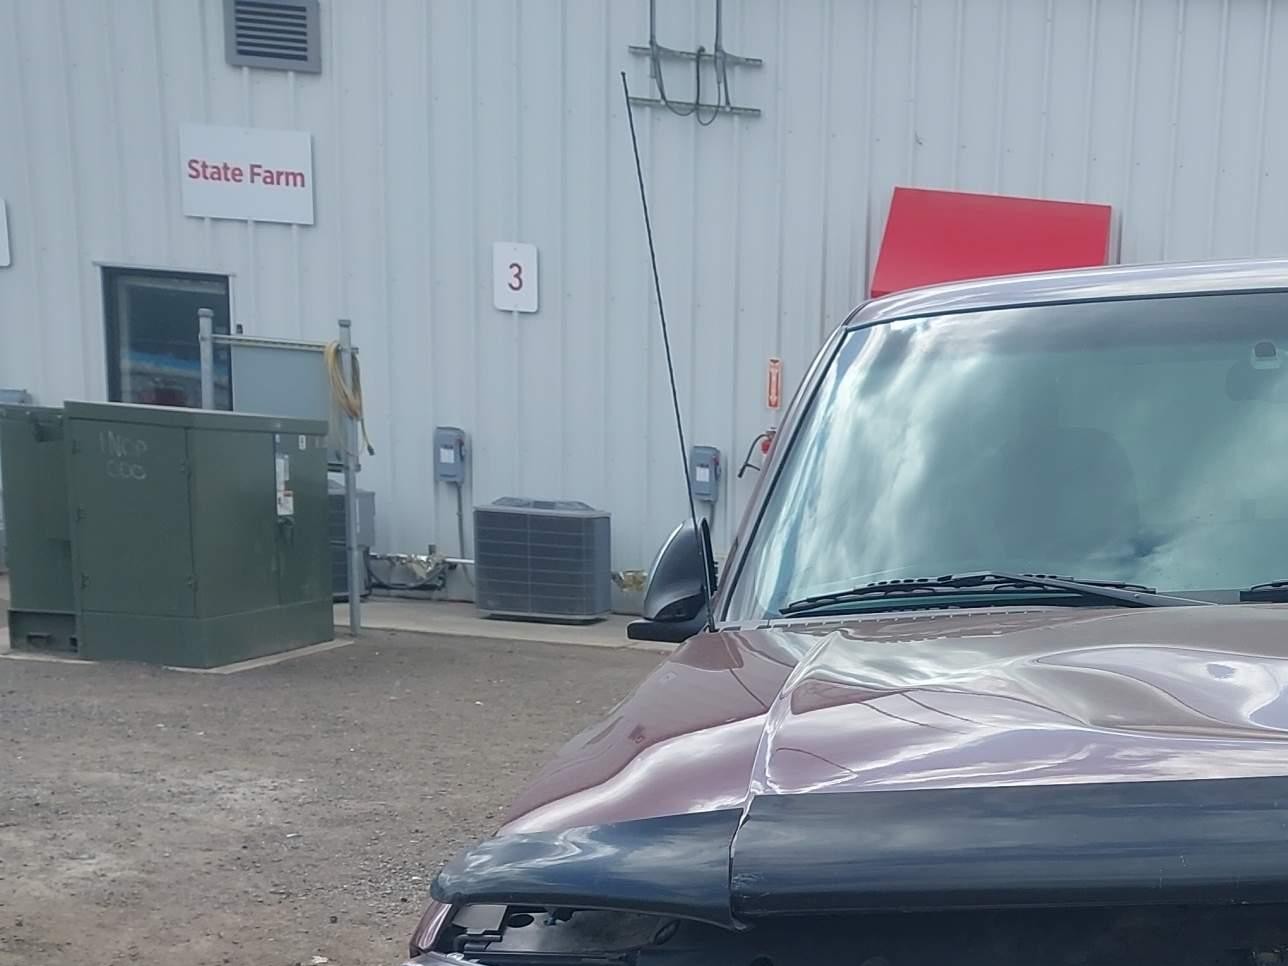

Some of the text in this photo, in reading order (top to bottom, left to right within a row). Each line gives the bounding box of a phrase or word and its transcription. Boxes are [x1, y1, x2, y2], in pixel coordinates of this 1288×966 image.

[188, 159, 305, 187] State Farm
[507, 262, 524, 292] 3
